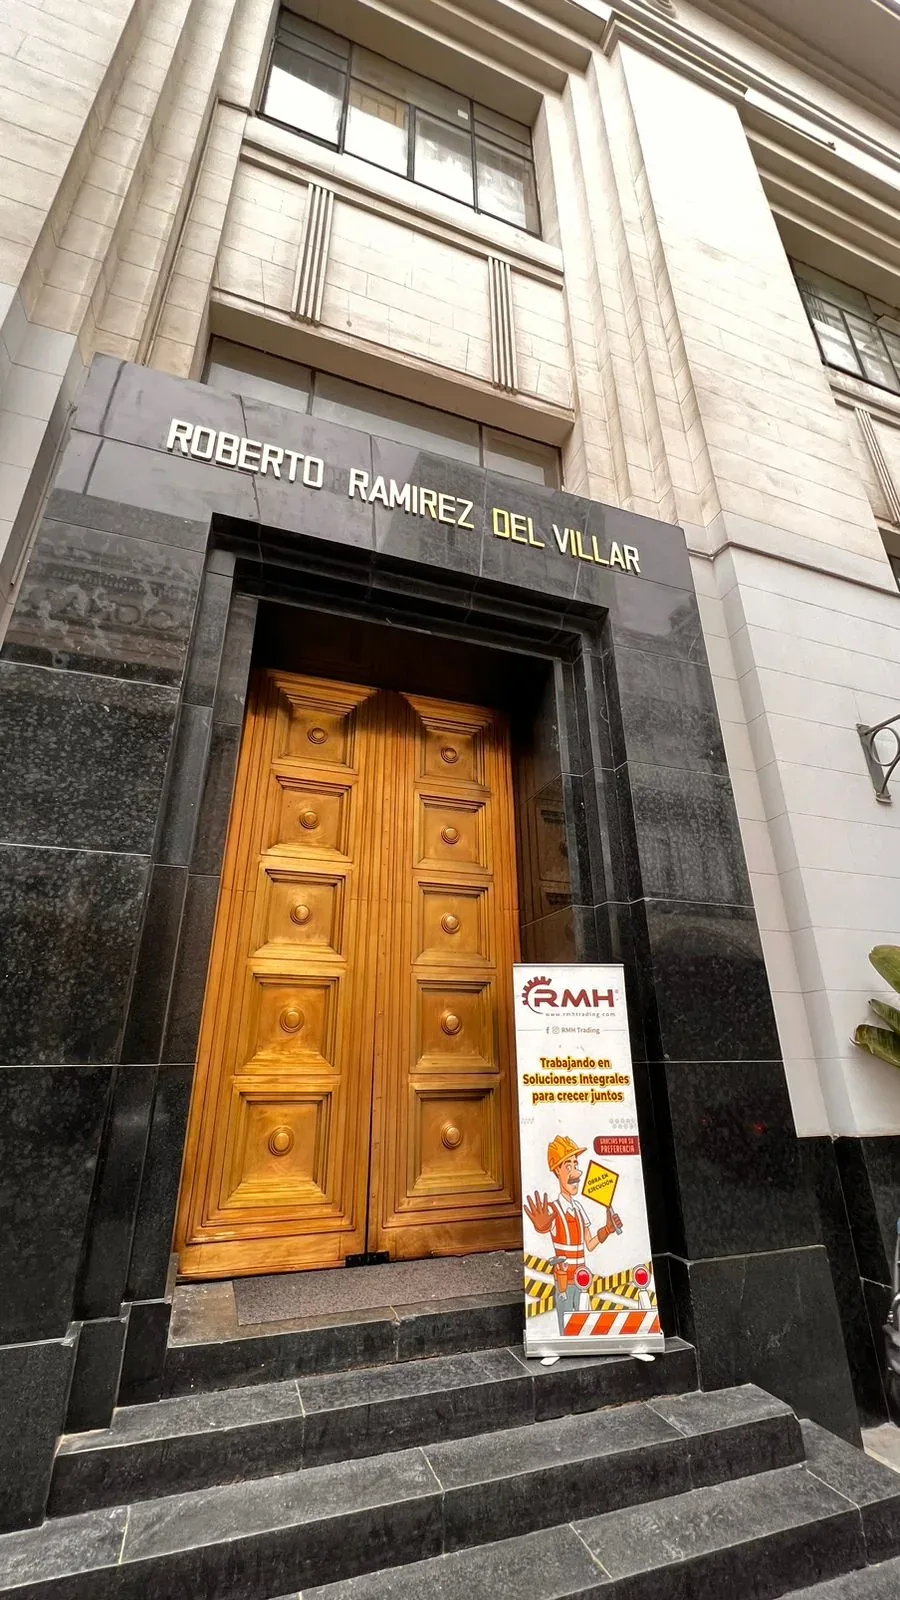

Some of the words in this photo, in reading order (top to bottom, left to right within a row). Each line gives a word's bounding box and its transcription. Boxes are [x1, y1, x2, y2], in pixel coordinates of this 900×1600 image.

[166, 418, 325, 490] ROBERTO
[348, 467, 475, 530] RAMIREZ
[492, 507, 545, 549] DEL
[552, 523, 641, 575] VILLAR
[533, 988, 615, 1008] RMH
[577, 1026, 600, 1035] Trading
[540, 1056, 595, 1071] Trabajando
[597, 1059, 610, 1068] en
[523, 1073, 577, 1085] Soluciones
[579, 1073, 630, 1087] Integrales
[532, 1092, 555, 1104] para
[557, 1091, 589, 1101] crecer
[591, 1089, 623, 1103] juntos
[600, 1145, 635, 1153] PREFERENCIA
[587, 1176, 602, 1186] OBRA
